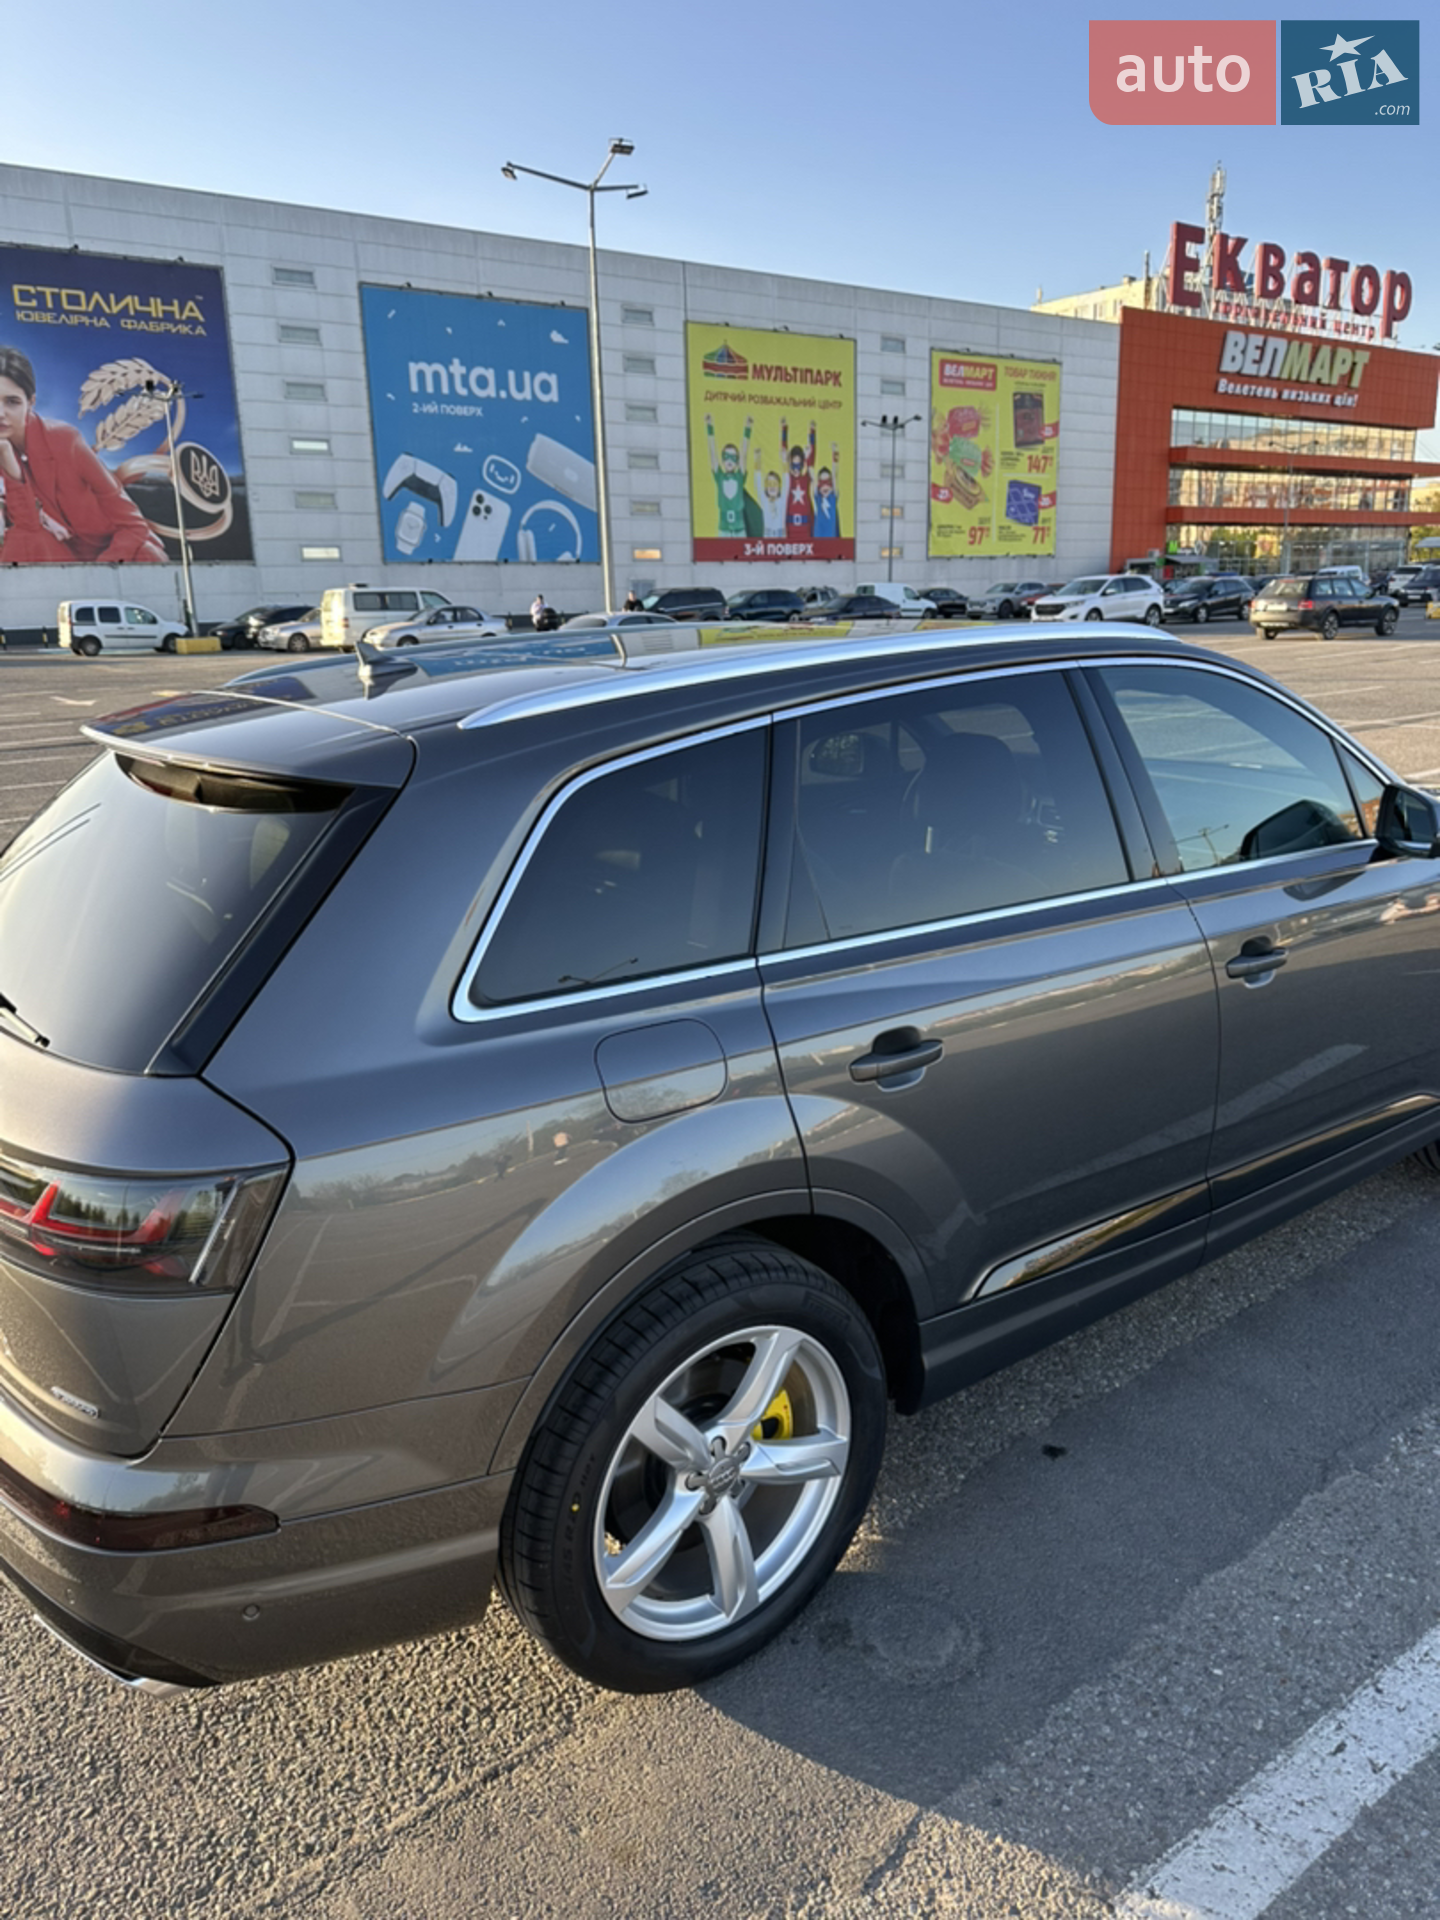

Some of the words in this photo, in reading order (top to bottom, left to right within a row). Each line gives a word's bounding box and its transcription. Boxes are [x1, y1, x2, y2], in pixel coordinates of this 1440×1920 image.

[1169, 221, 1412, 339] Екватор
[12, 284, 205, 322] СТОЛИЧНА
[16, 310, 111, 329] ЮВЕЛІРНА
[120, 318, 207, 337] ФАБРИКА
[1218, 330, 1371, 389] ВЕЛМАРТ
[408, 357, 560, 403] mta.ua
[752, 362, 843, 388] МУЛЬТІПАРК
[1216, 378, 1279, 400] Велетень
[412, 401, 439, 415] 2-ИЙ
[440, 404, 484, 418] ПОВЕРХ
[744, 540, 765, 556] 3-Й
[767, 543, 815, 556] ПОВЕРХ
